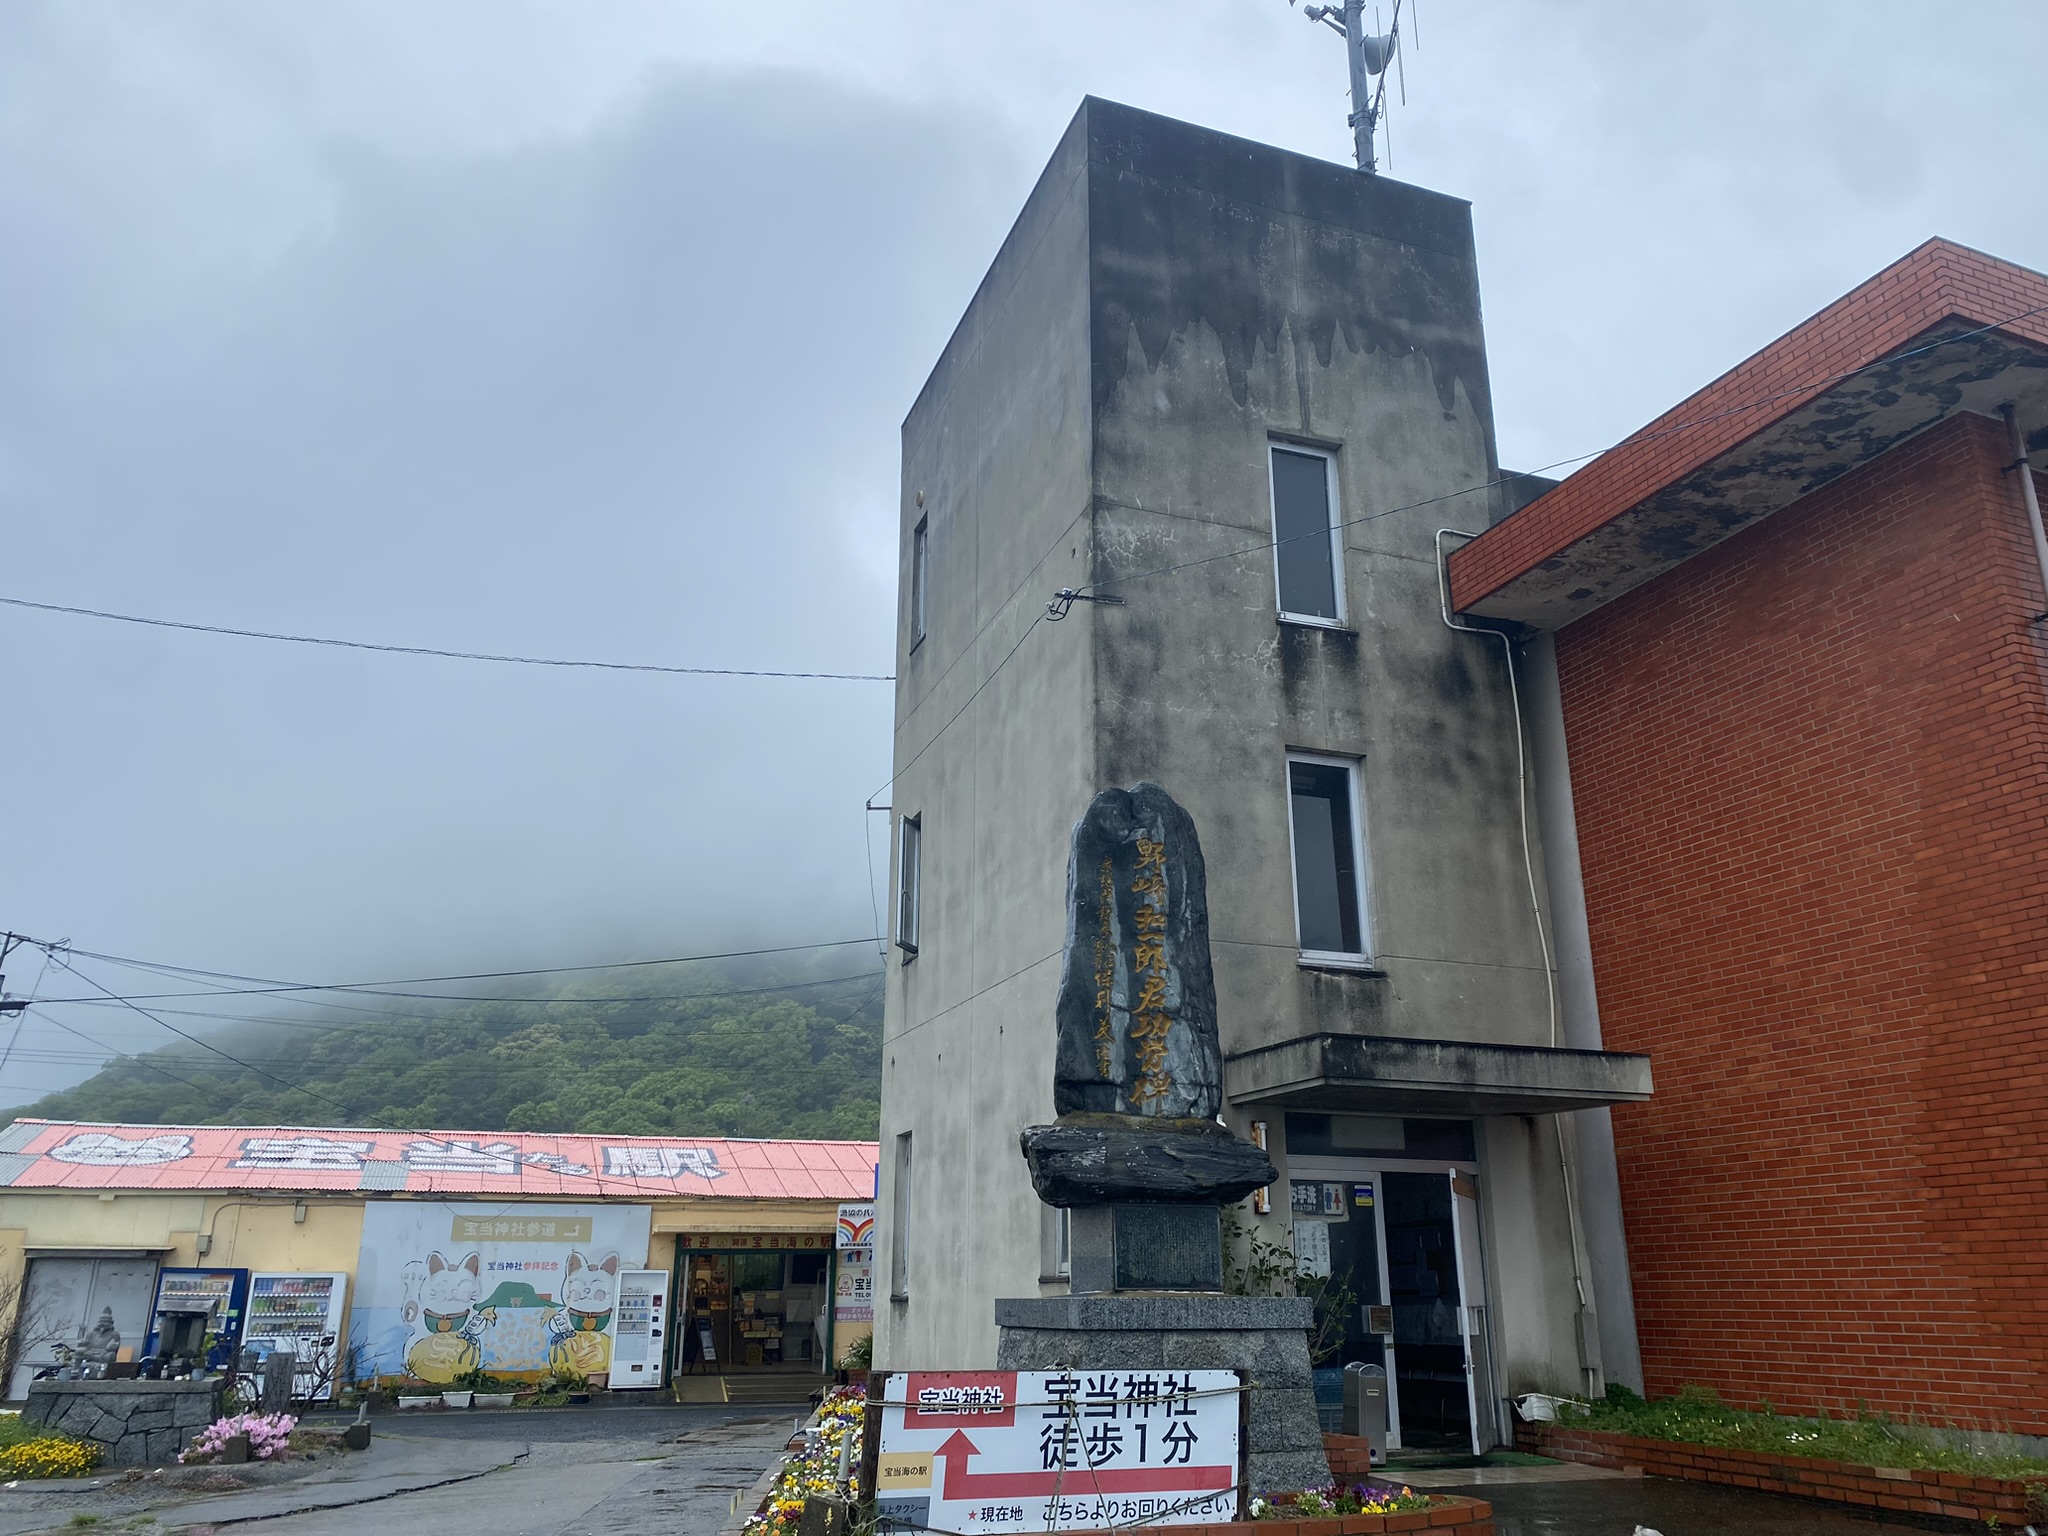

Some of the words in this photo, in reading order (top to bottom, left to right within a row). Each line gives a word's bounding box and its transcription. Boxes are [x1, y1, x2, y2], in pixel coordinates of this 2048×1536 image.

[463, 1221, 556, 1237] 宝当神社参道
[682, 1236, 710, 1248] 歓迎
[752, 1236, 832, 1248] 宝当海の駅
[487, 1261, 559, 1271] 宝当神社参拝記念
[918, 1386, 1005, 1415] 宝当神社
[1042, 1373, 1198, 1420] 宝当神社
[1040, 1421, 1199, 1470] 徒歩1分
[884, 1466, 928, 1477] 宝当海の駅
[878, 1503, 927, 1515] 海上タクシー
[981, 1506, 1024, 1522] 現在地
